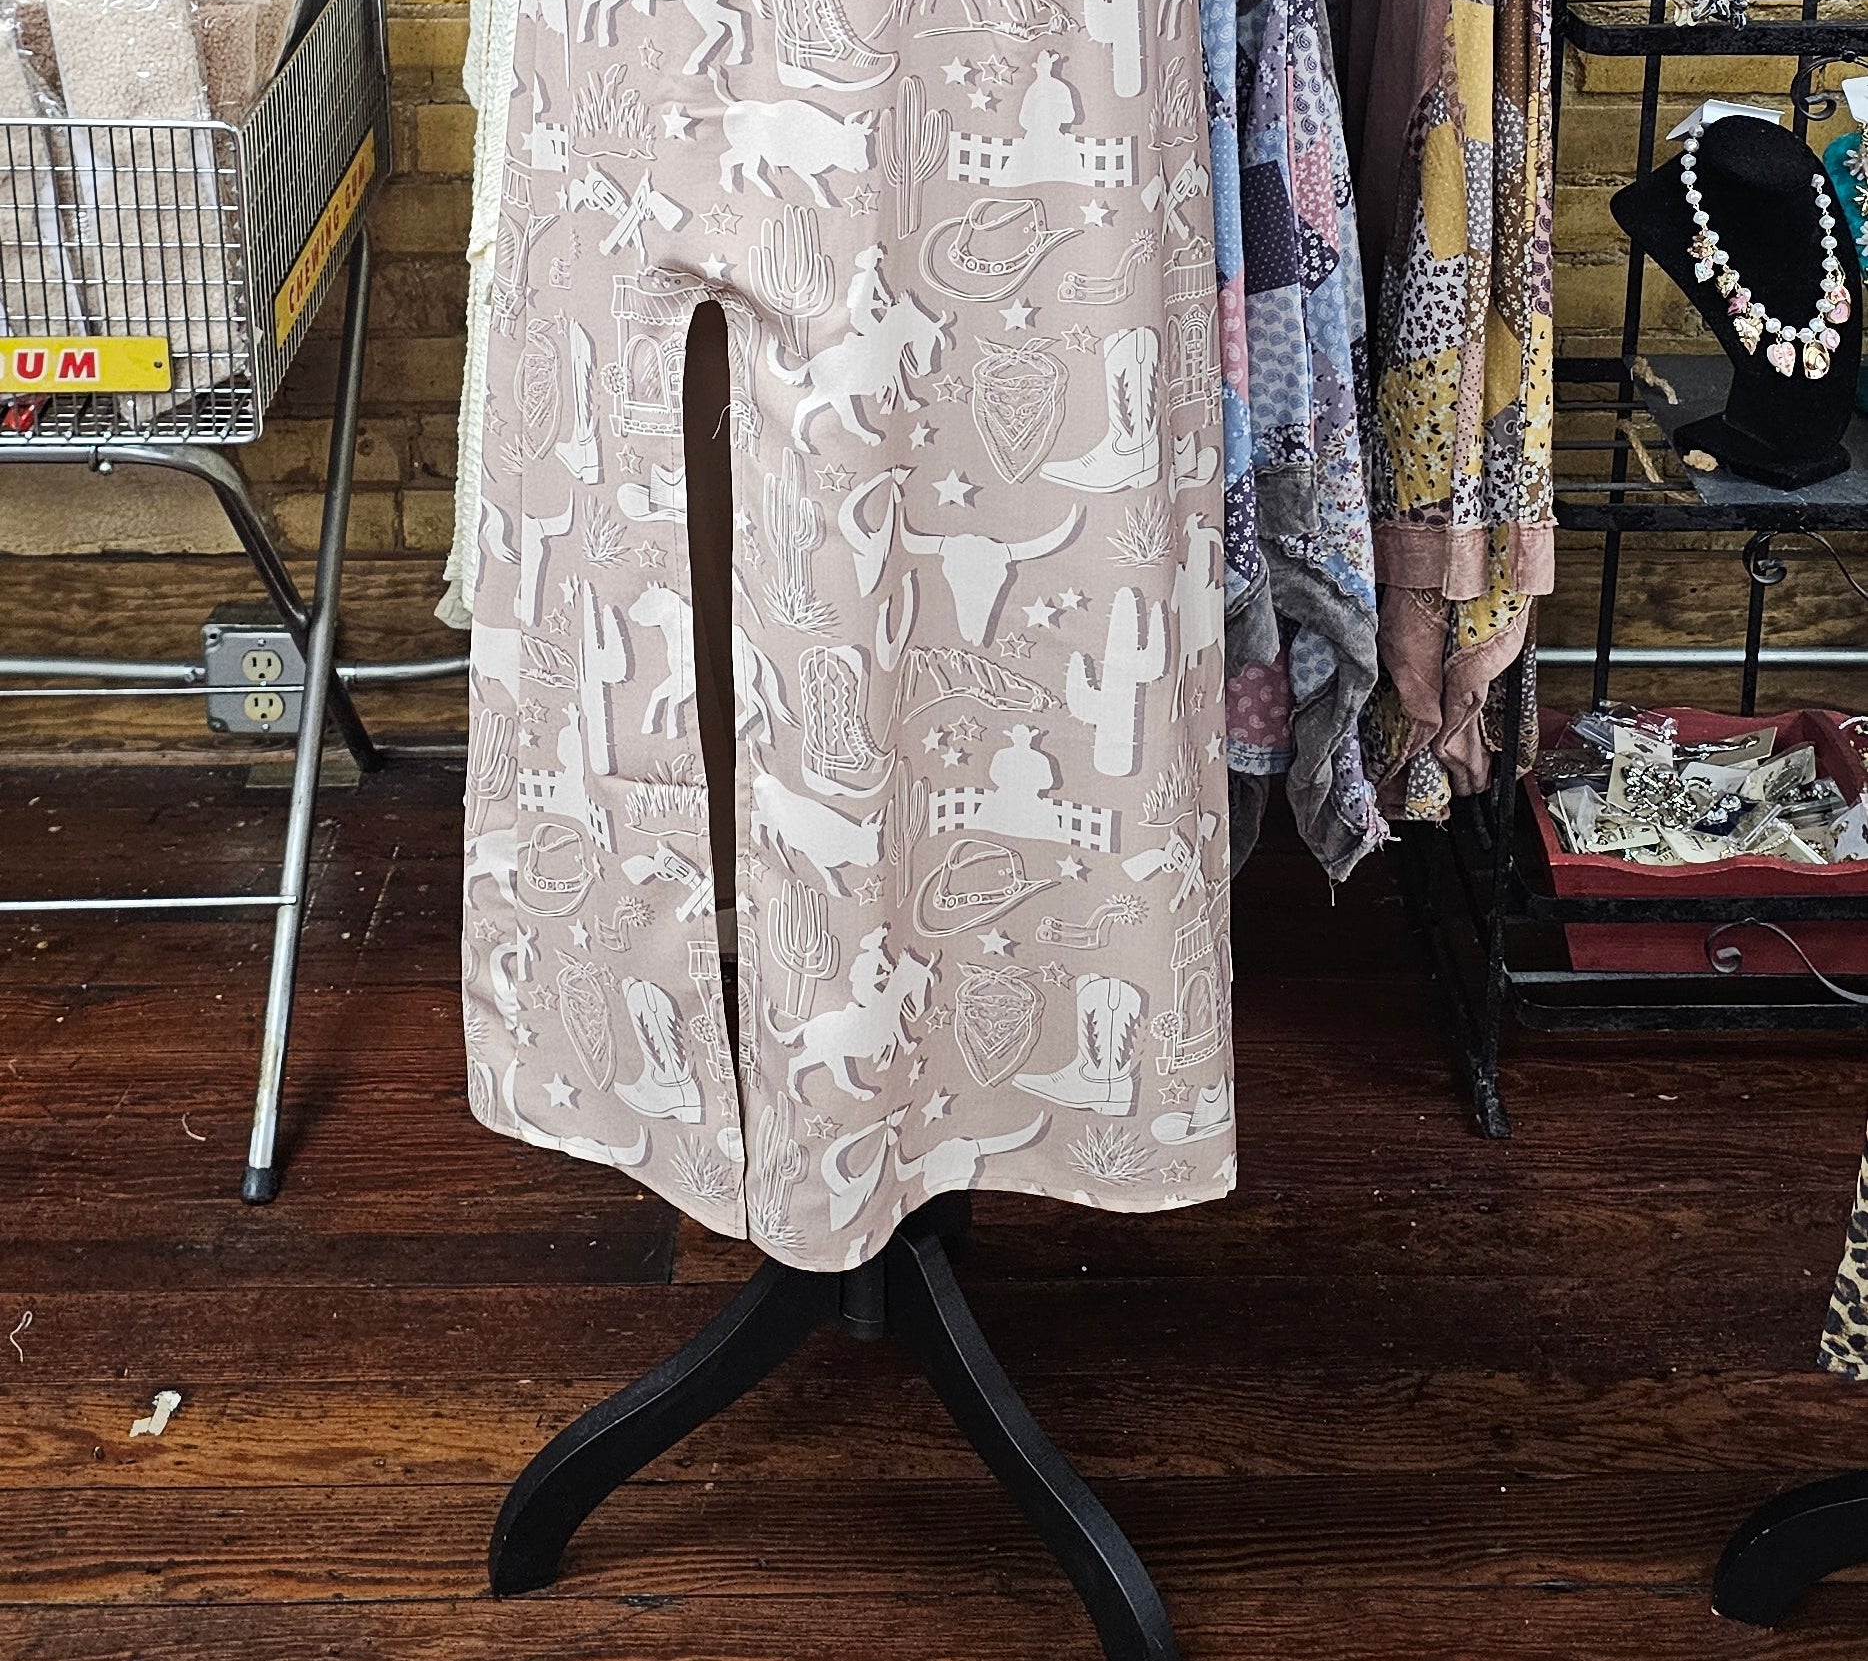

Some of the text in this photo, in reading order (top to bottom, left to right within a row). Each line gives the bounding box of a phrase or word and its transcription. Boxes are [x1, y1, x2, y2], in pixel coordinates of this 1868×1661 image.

[288, 158, 366, 314] CHEWING GUM
[0, 350, 98, 381] UM
